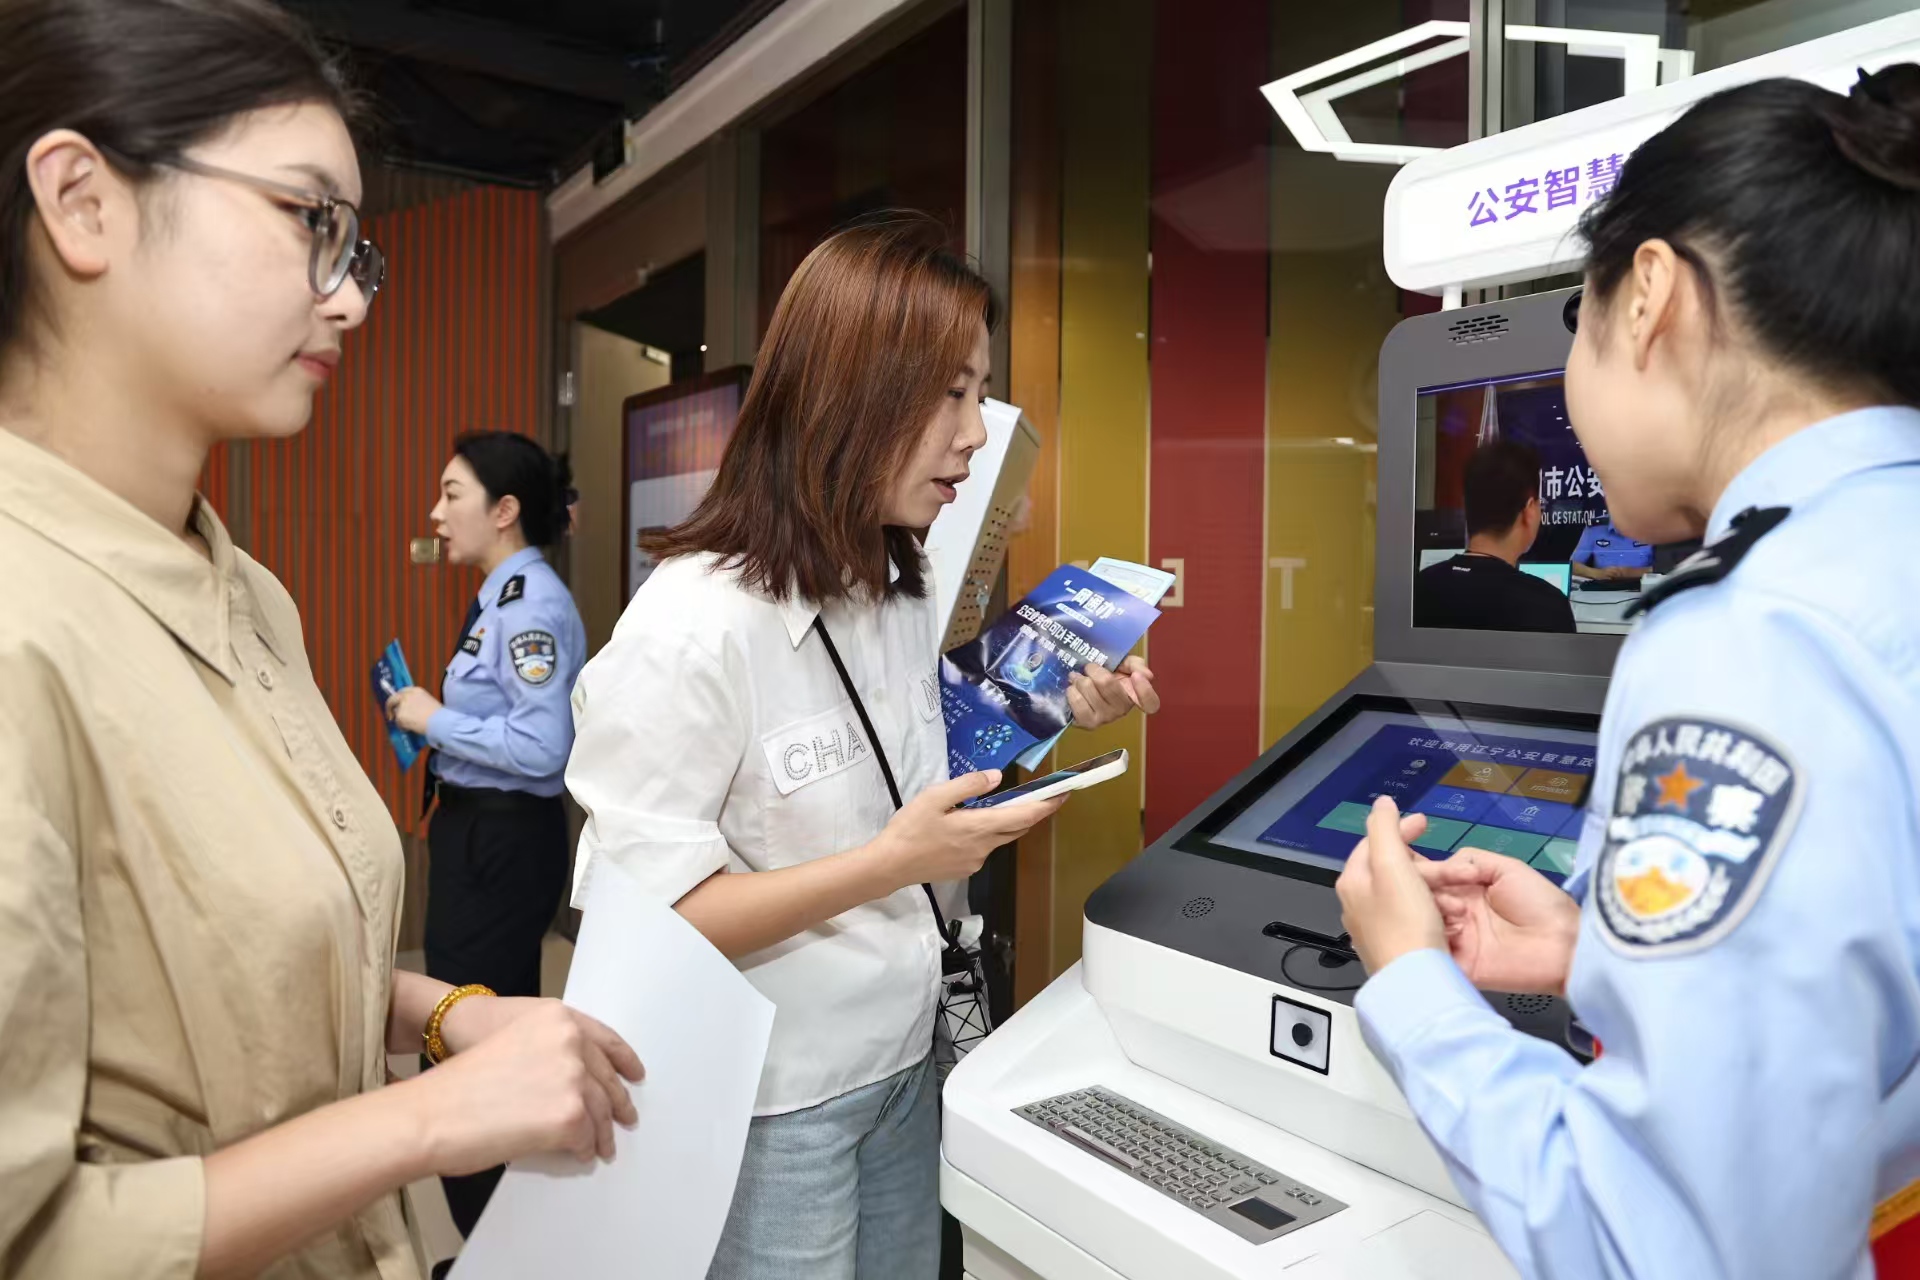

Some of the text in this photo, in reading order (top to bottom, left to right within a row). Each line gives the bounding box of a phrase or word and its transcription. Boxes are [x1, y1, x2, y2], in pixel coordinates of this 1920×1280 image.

[1467, 153, 1624, 227] 公安智慧
[1539, 465, 1605, 499] 市公安
[783, 721, 866, 781] CHA
